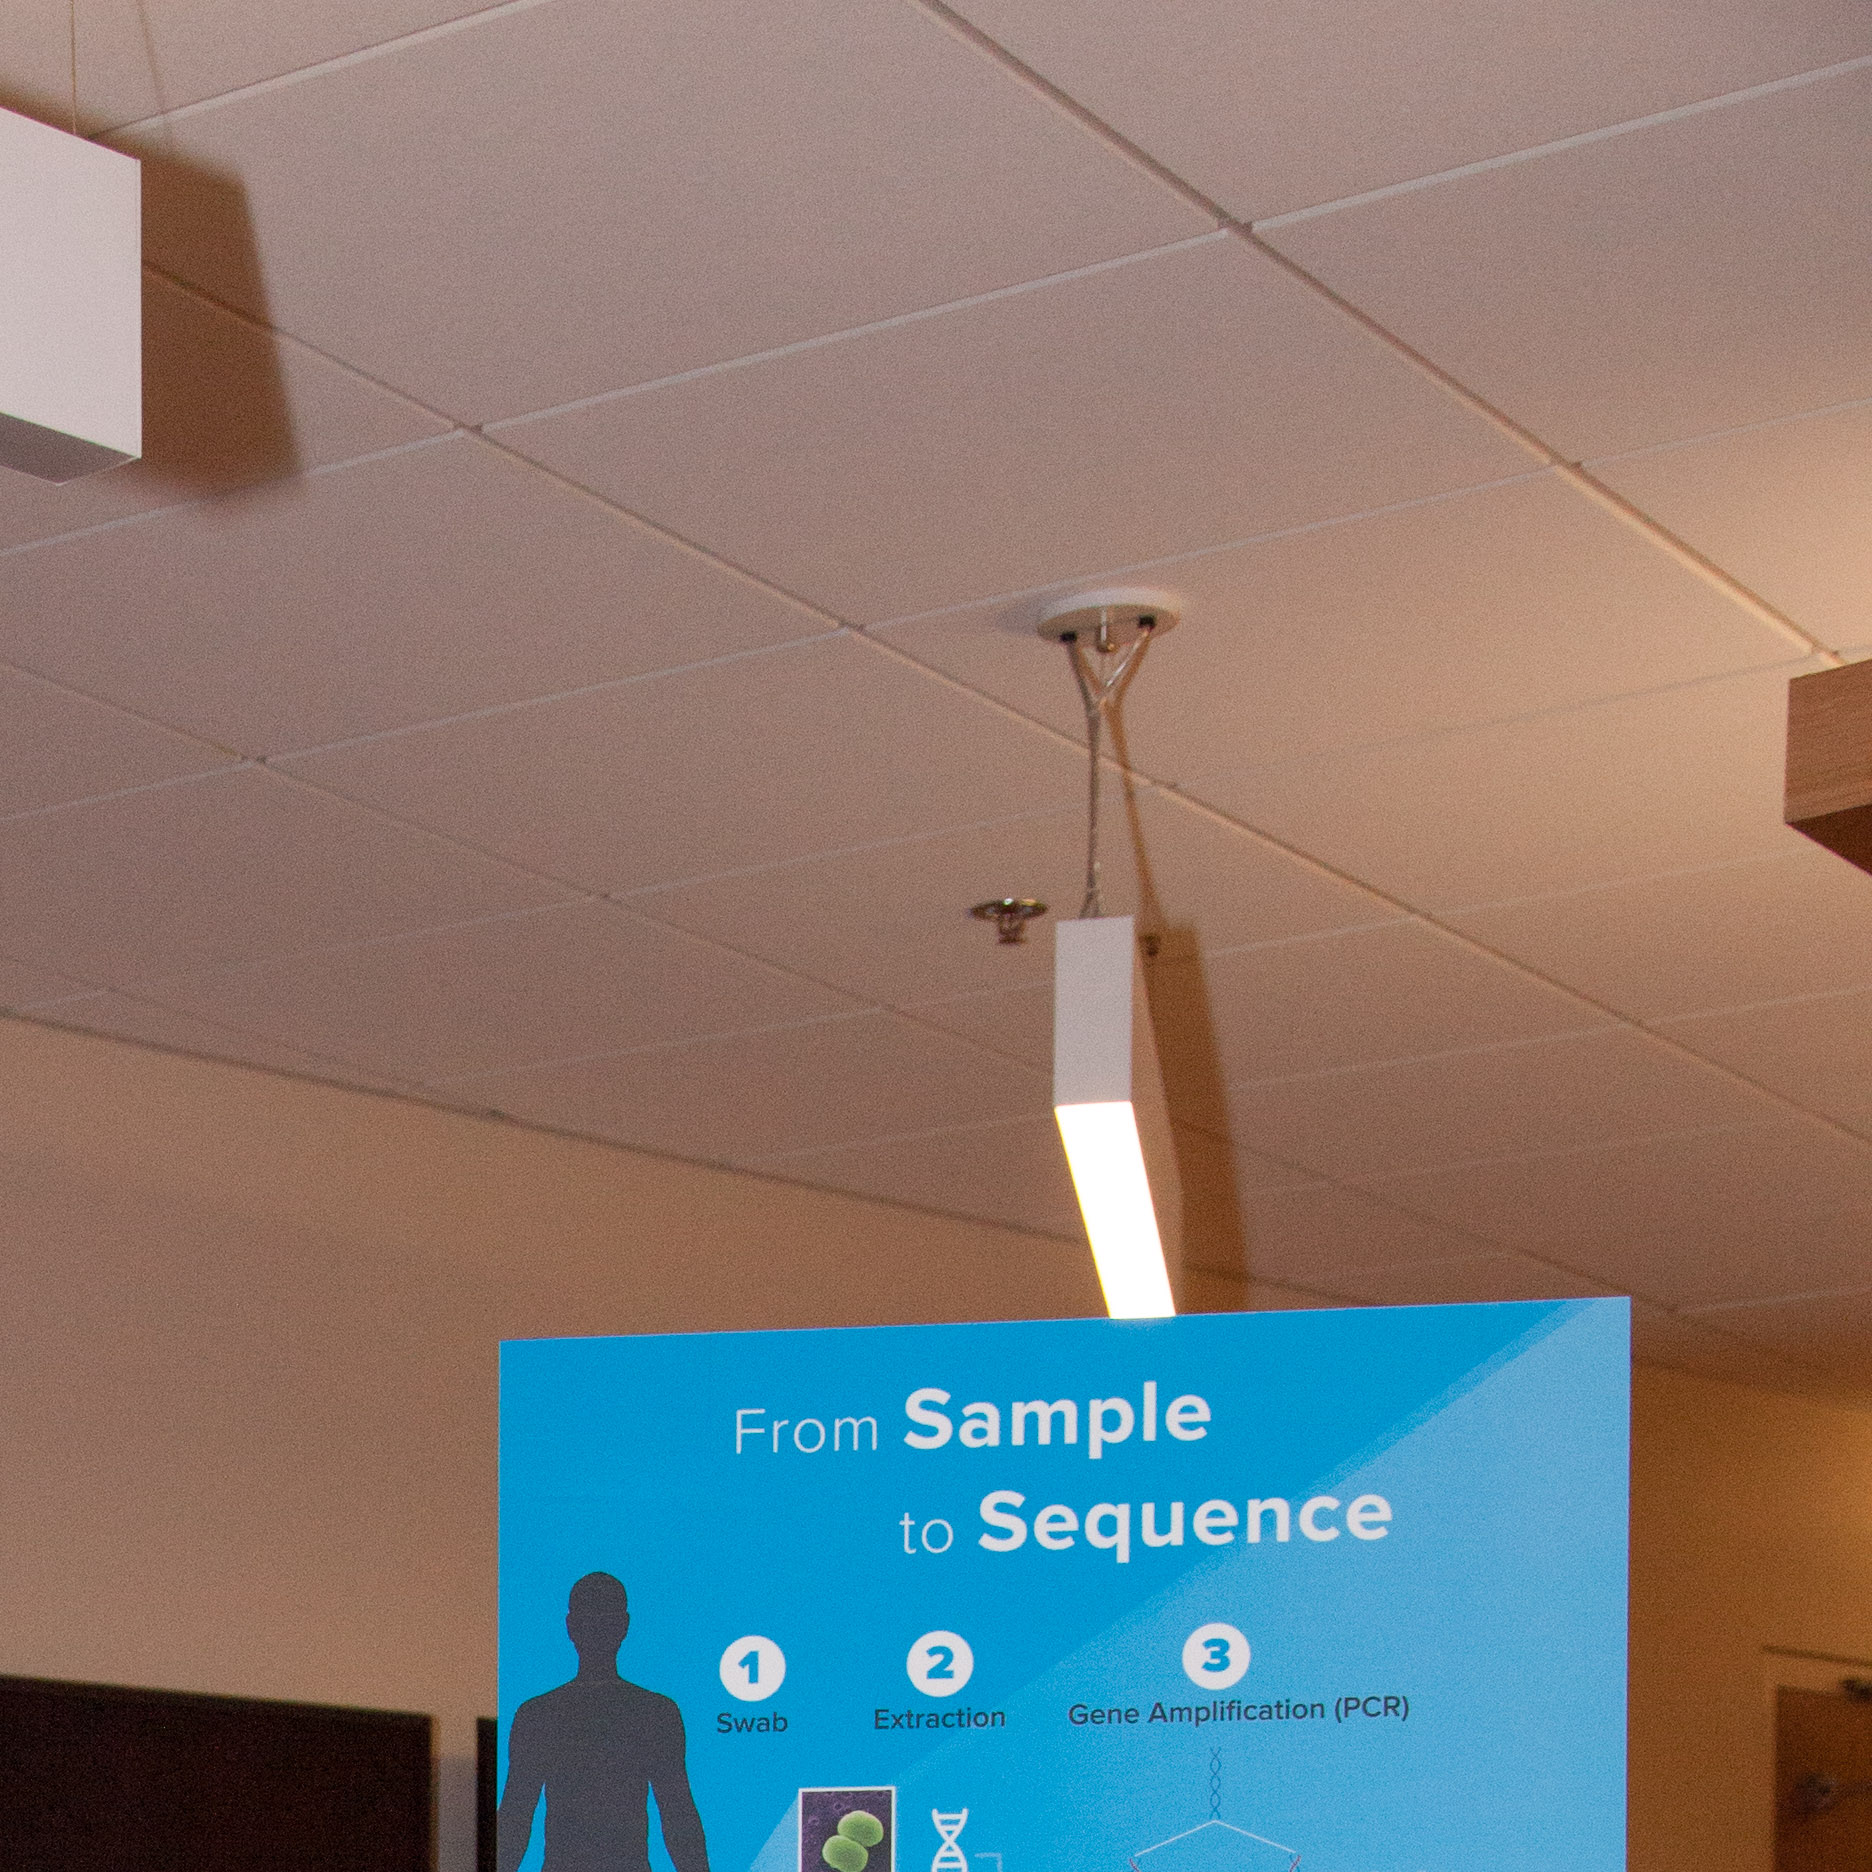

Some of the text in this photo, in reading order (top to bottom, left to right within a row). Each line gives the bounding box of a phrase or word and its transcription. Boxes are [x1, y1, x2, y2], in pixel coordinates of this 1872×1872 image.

[736, 1381, 1211, 1459] From Sample
[900, 1491, 1392, 1562] to Sequence
[739, 1651, 759, 1683] 1
[927, 1646, 953, 1679] 2
[1203, 1638, 1230, 1672] 3
[717, 1712, 788, 1734] Swab
[874, 1707, 1005, 1730] Extraction
[1068, 1696, 1409, 1727] Gene Amplification (PCR)
